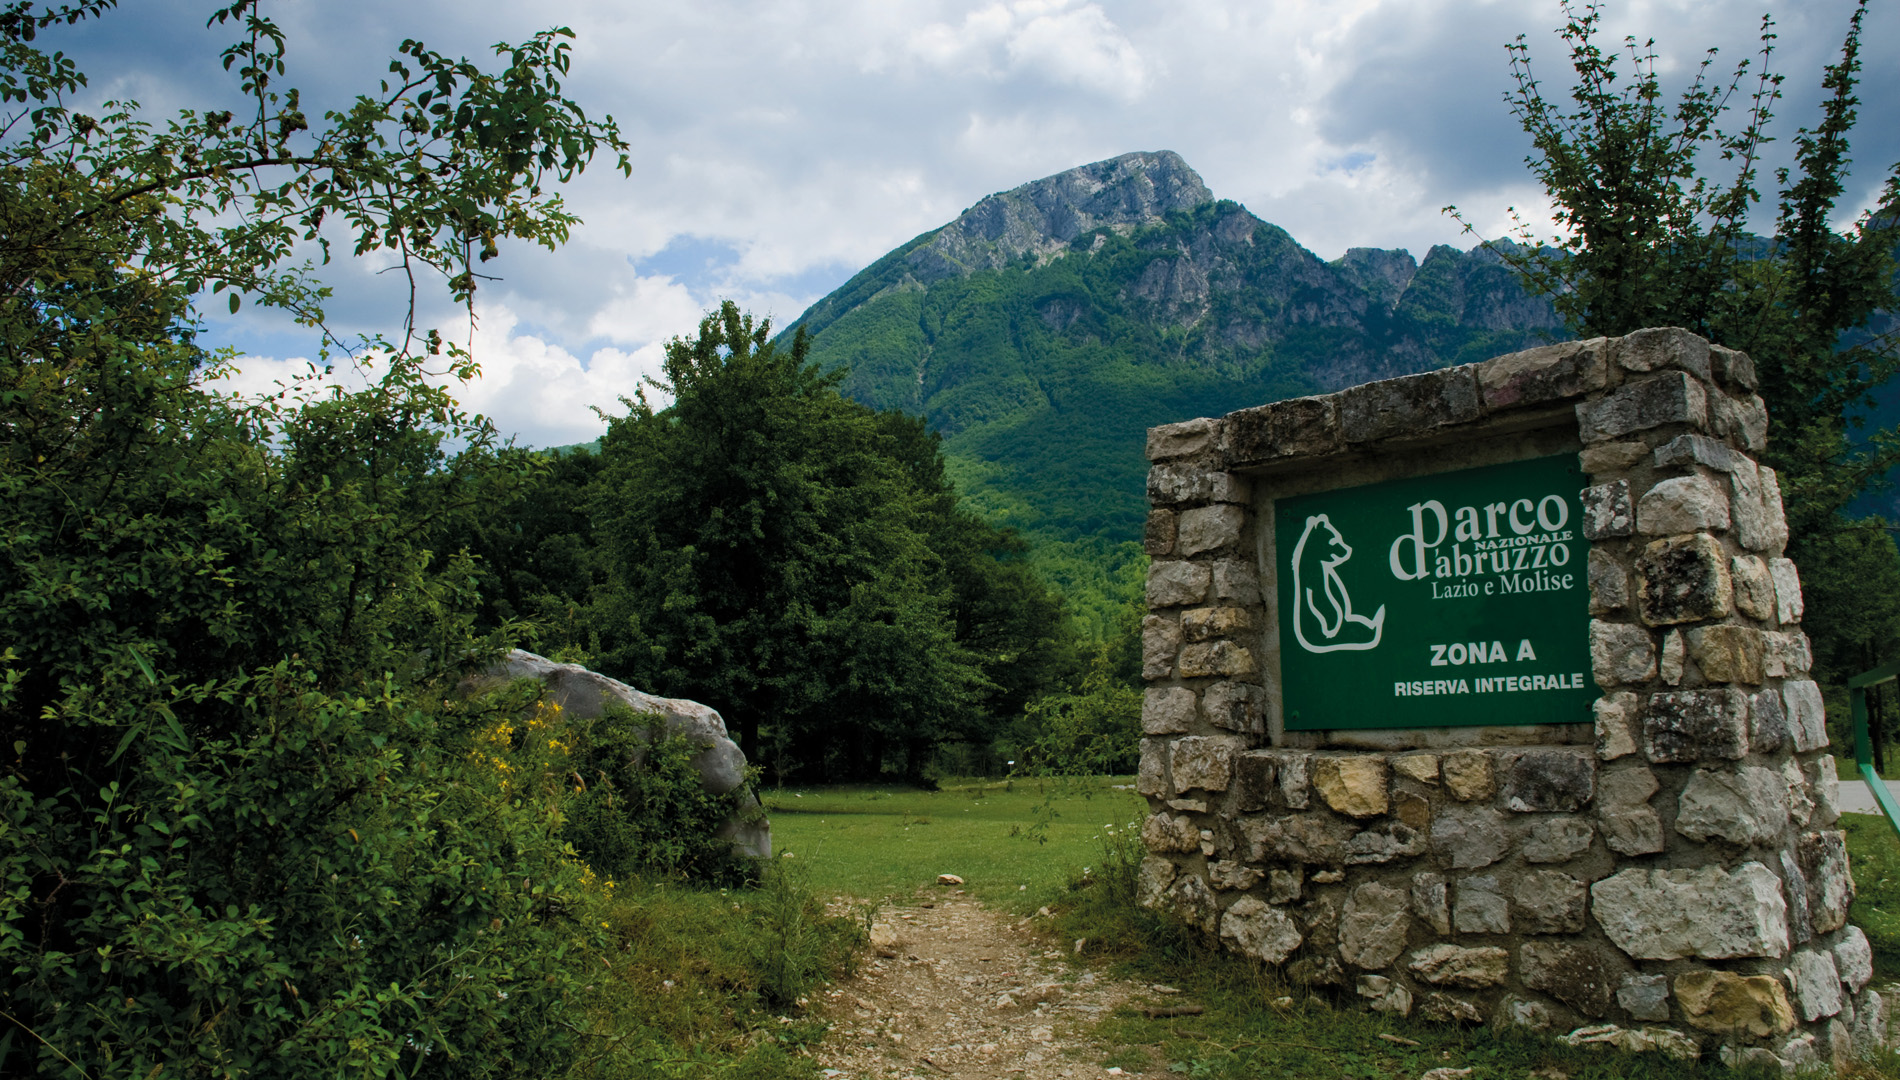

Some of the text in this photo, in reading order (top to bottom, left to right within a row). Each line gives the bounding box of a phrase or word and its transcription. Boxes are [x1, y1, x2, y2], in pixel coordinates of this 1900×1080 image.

[1474, 530, 1574, 552] NAZIONALE
[1431, 570, 1575, 600] Lazio e Molise
[1430, 639, 1537, 667] ZONA A
[1394, 672, 1585, 697] RISERVA INTEGRALE
